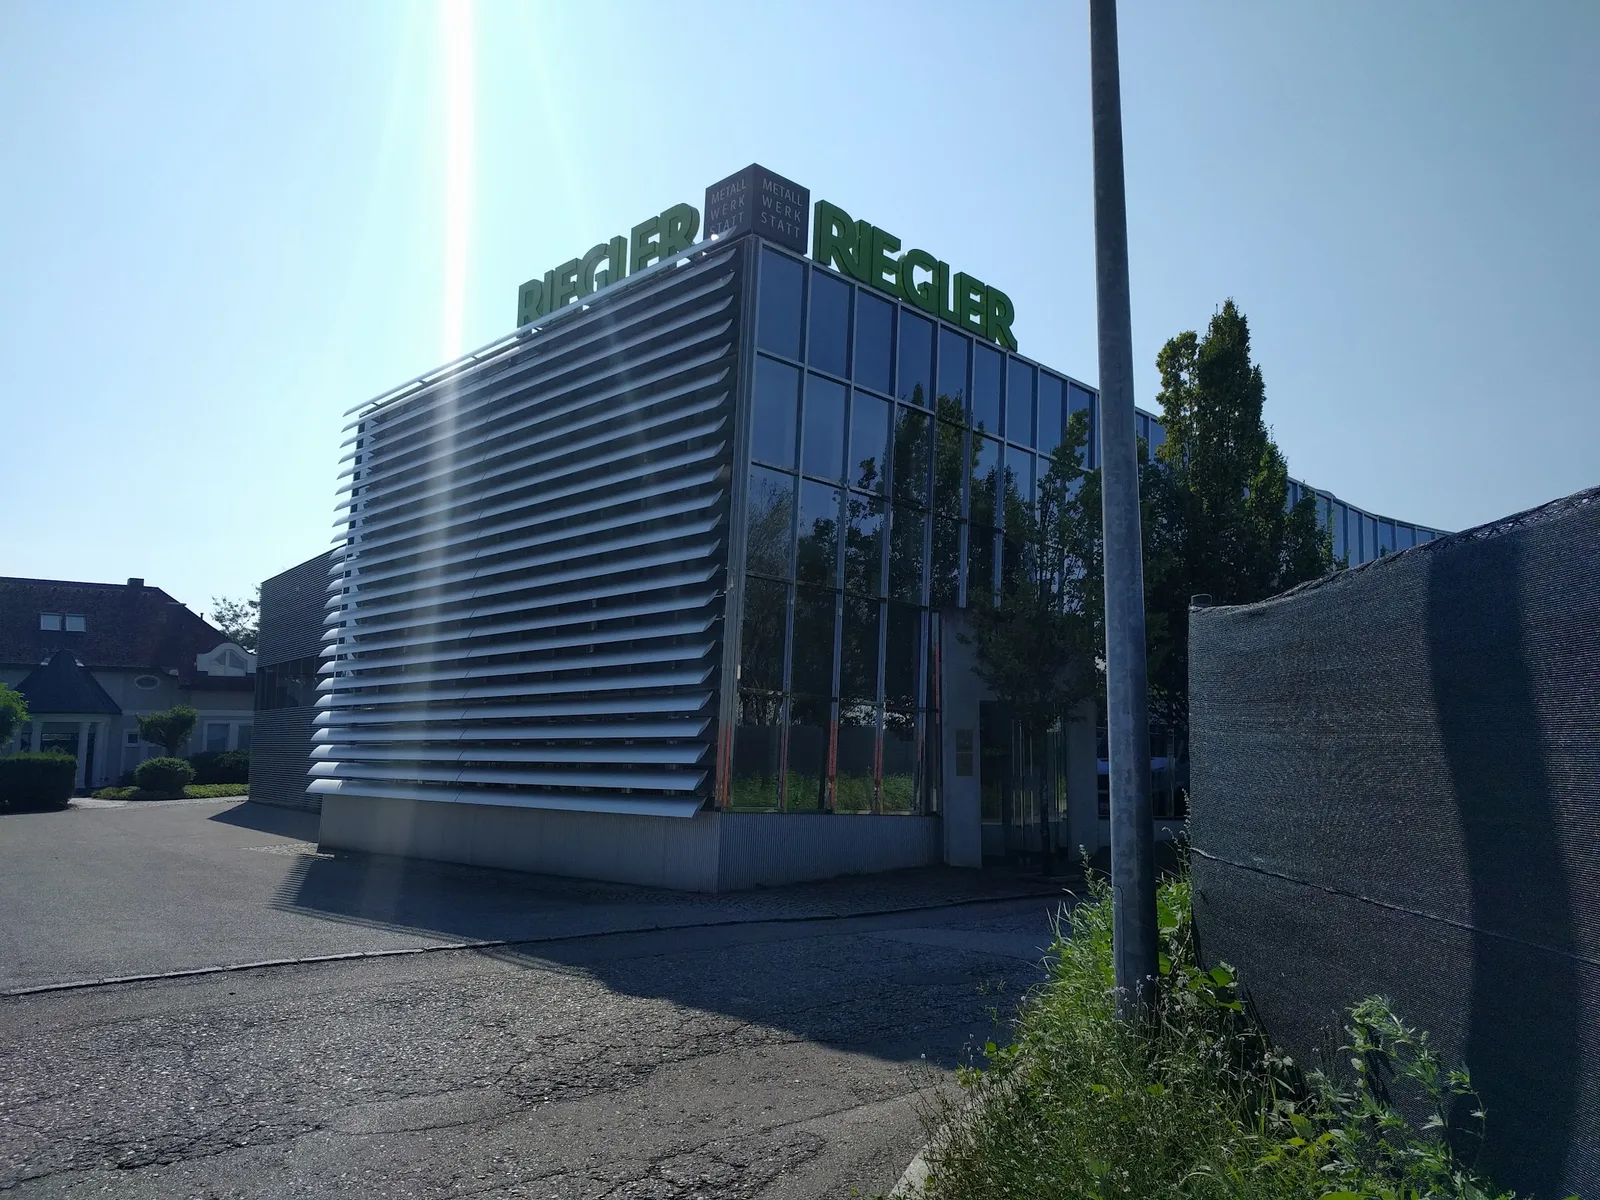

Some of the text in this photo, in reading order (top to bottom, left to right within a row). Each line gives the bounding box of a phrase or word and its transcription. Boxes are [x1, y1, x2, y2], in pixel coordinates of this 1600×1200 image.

[711, 178, 747, 205] METALL
[762, 178, 803, 207] METALL
[710, 194, 745, 221] WERK
[762, 194, 801, 223] WERK
[709, 211, 745, 235] STATT
[761, 211, 801, 239] STATT
[812, 199, 1018, 353] RIEGLER
